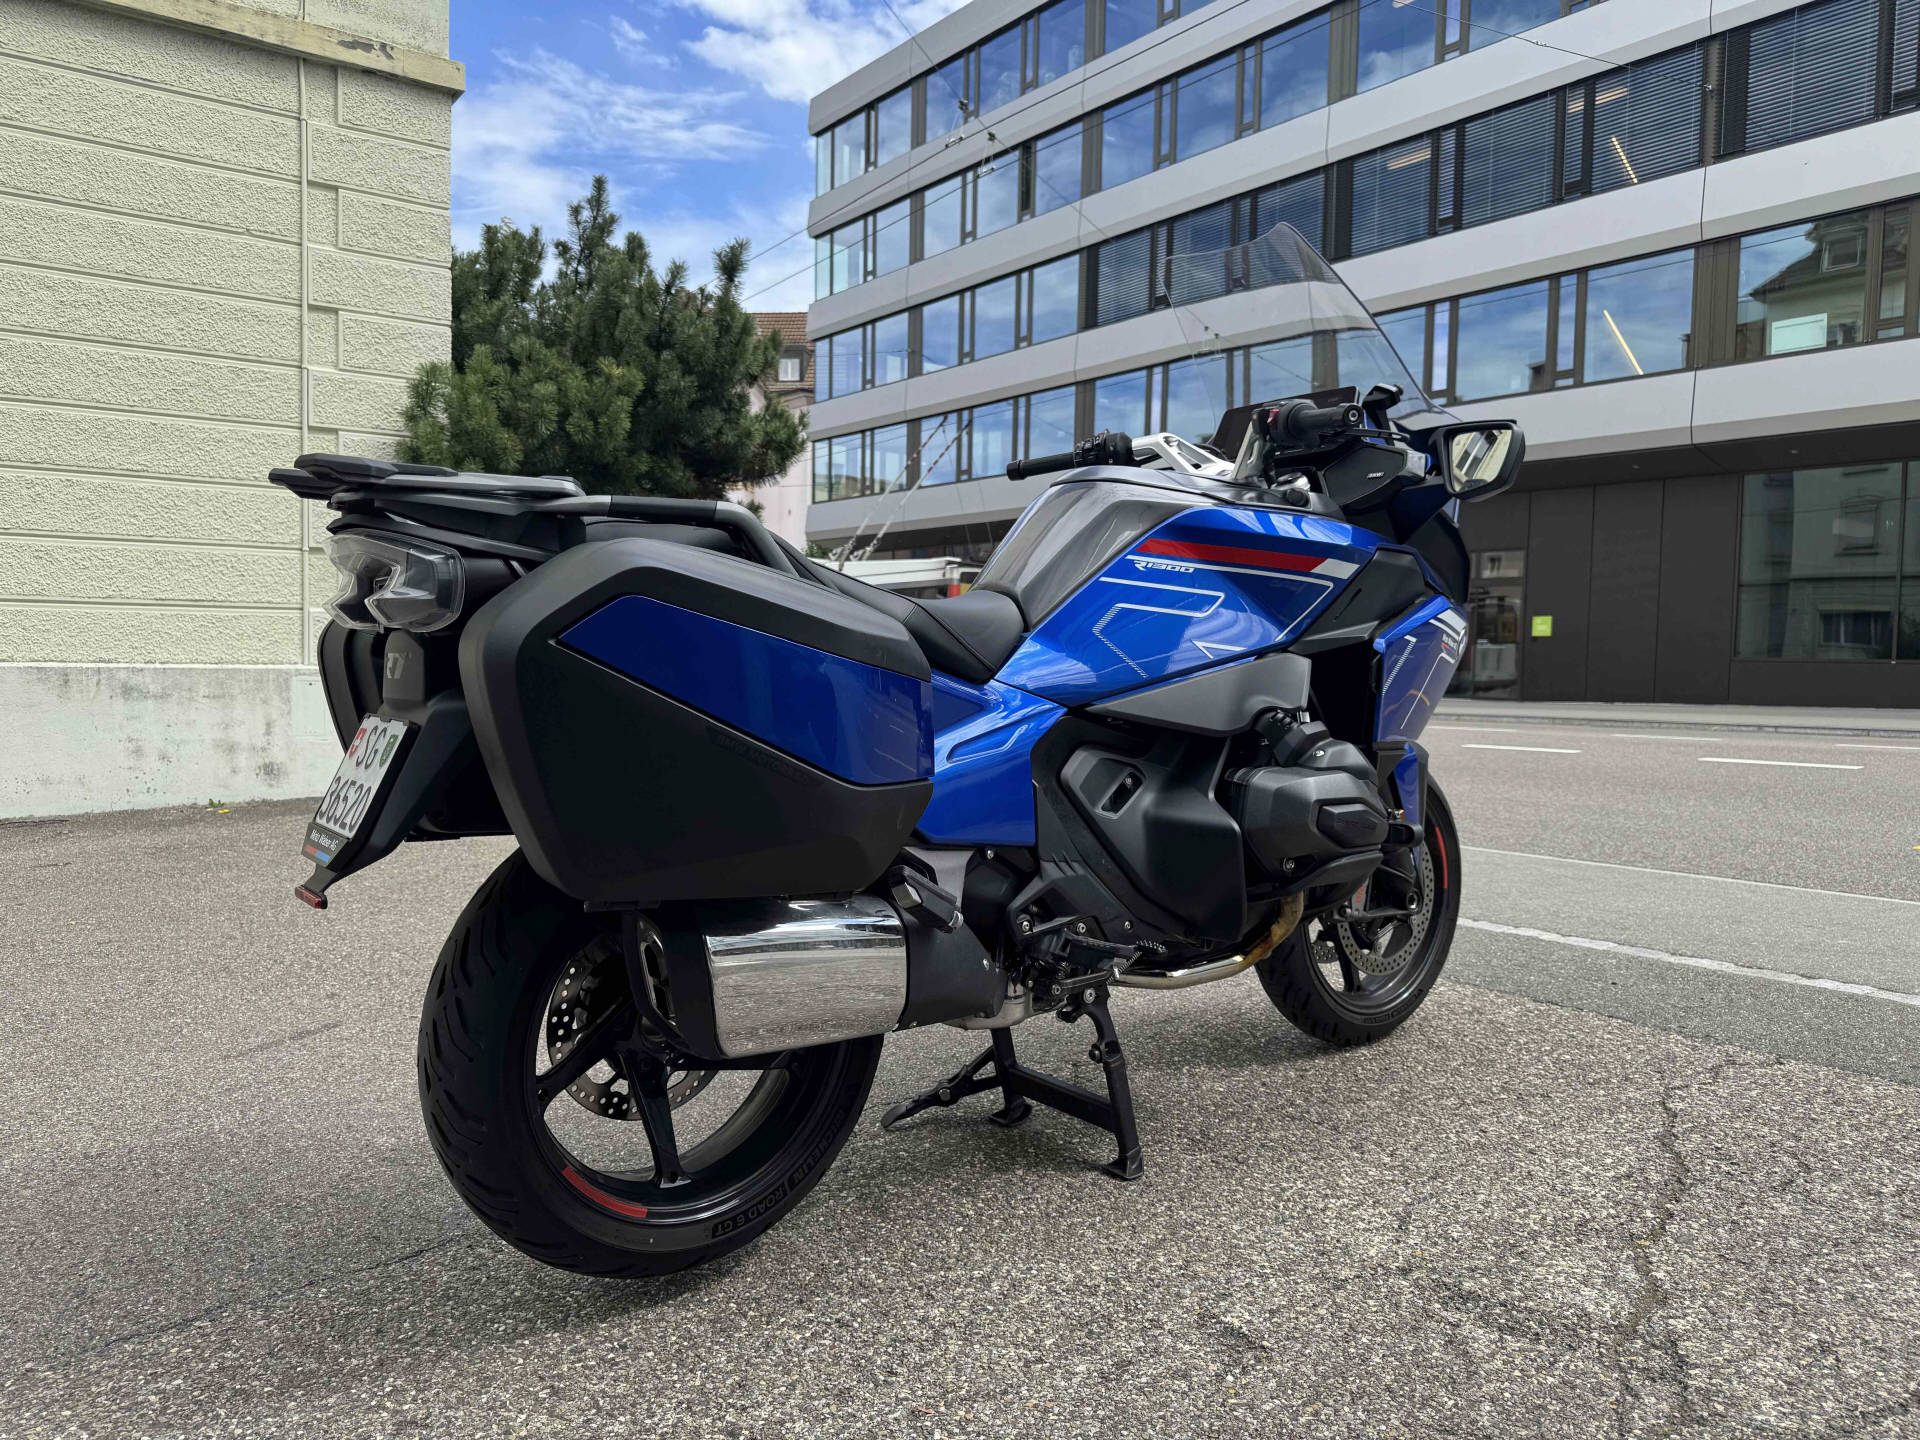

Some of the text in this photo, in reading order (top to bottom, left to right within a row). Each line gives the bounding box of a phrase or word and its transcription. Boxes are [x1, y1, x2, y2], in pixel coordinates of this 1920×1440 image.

[356, 725, 387, 770] SG
[318, 775, 372, 833] 36520
[750, 1183, 785, 1219] ROAD
[715, 1220, 733, 1236] GT
